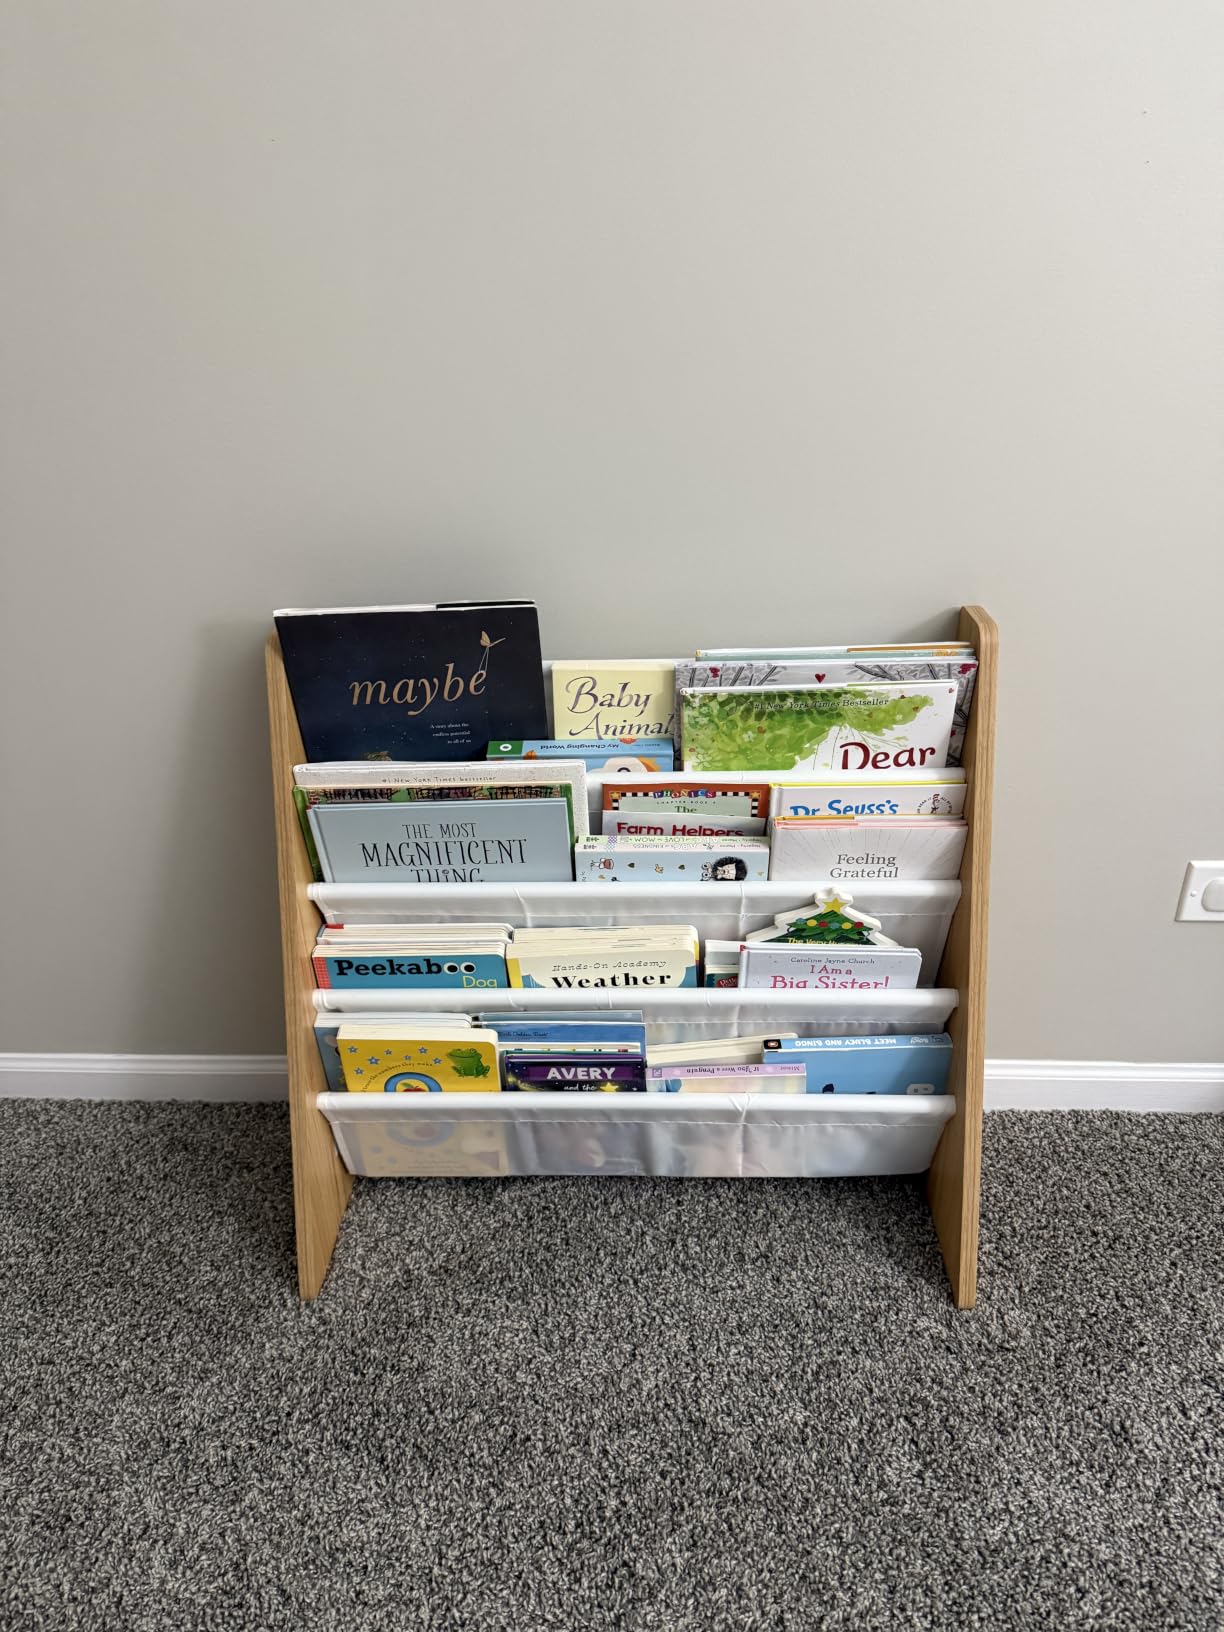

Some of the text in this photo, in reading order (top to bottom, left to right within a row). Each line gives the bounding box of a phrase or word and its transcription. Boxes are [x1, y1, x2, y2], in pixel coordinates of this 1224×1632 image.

[350, 663, 486, 715] maybe
[565, 676, 653, 717] Baby
[766, 702, 784, 710] New
[788, 701, 810, 709] York
[813, 700, 840, 708] Times
[842, 698, 889, 707] Bestseller
[569, 711, 676, 740] Animal
[839, 742, 936, 769] Dear
[654, 789, 716, 798] PHONICS
[675, 805, 697, 813] The
[827, 799, 899, 815] Seuss's
[402, 822, 478, 839] THE MOST
[617, 822, 744, 836] Farm Helpers
[358, 839, 528, 867] MAGNIFICENT
[837, 853, 896, 867] Feeling
[830, 867, 898, 878] Grateful
[334, 958, 476, 976] Peekaboo
[552, 959, 667, 972] Hands-On Academy
[810, 964, 816, 974] I
[818, 964, 842, 975] Am
[462, 976, 497, 988] Dog
[552, 972, 672, 988] Weather
[771, 975, 890, 988] Big Sister!
[795, 1039, 823, 1047] BINGO
[824, 1038, 843, 1046] AND
[845, 1038, 872, 1046] BLUEY
[547, 1067, 616, 1080] AVERY
[564, 1083, 597, 1091] and the
